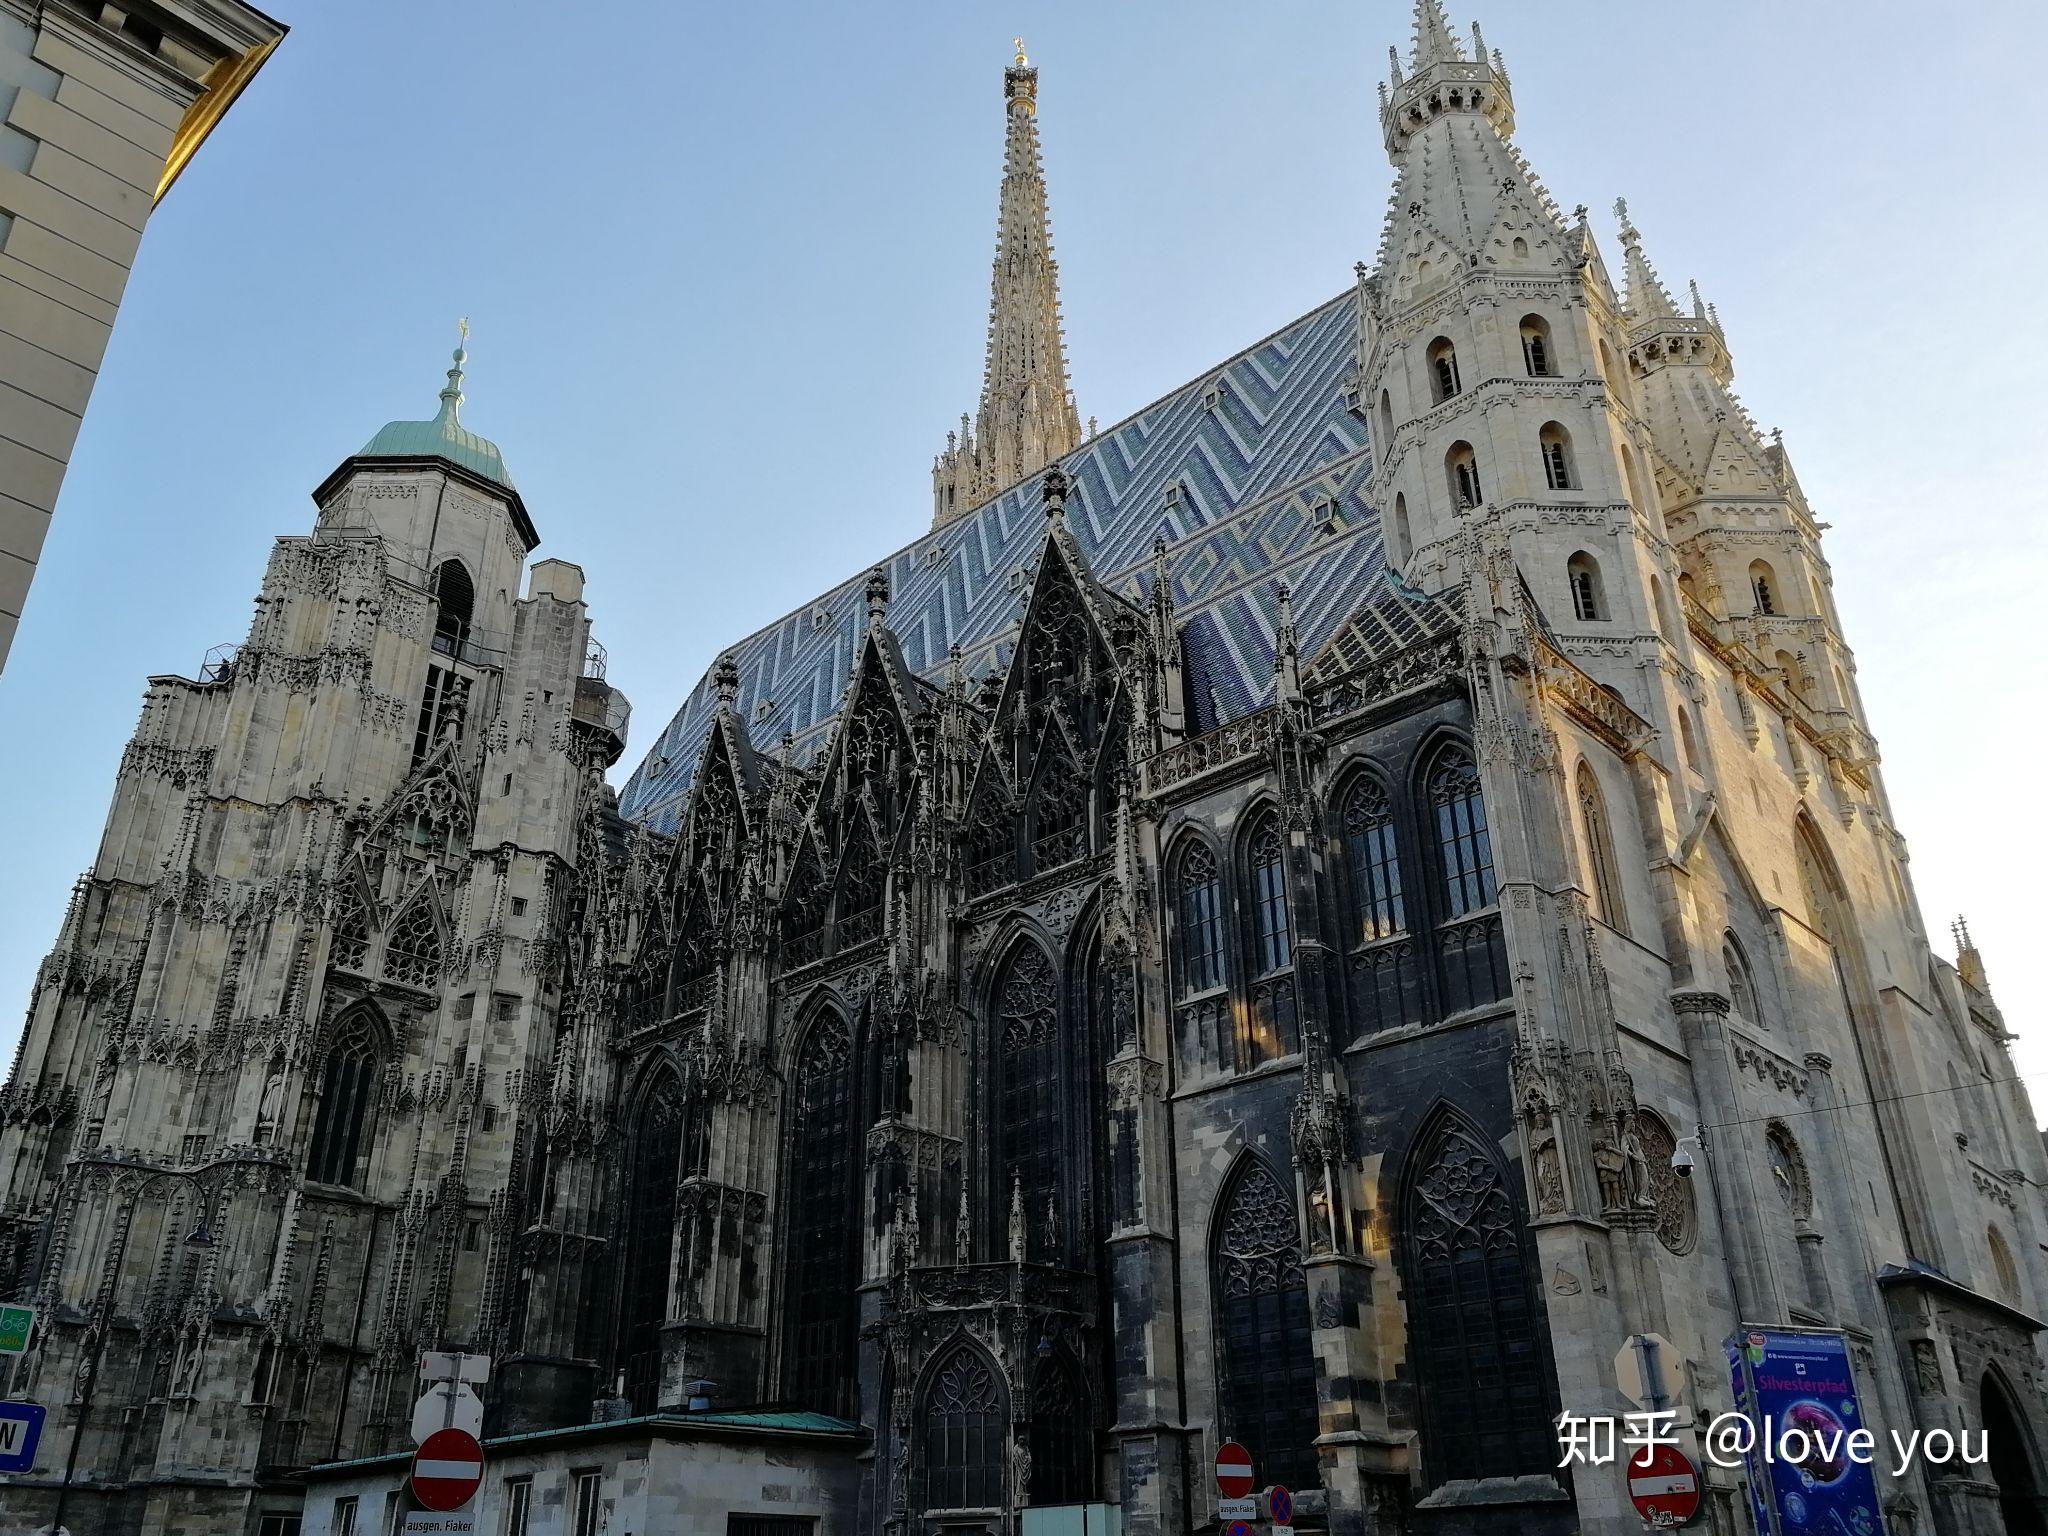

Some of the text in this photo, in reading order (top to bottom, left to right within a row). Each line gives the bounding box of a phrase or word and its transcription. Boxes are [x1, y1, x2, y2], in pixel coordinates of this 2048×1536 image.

[1759, 1375, 1848, 1396] Silvesterpfad
[407, 1520, 472, 1533] ausgen. Fiaker
